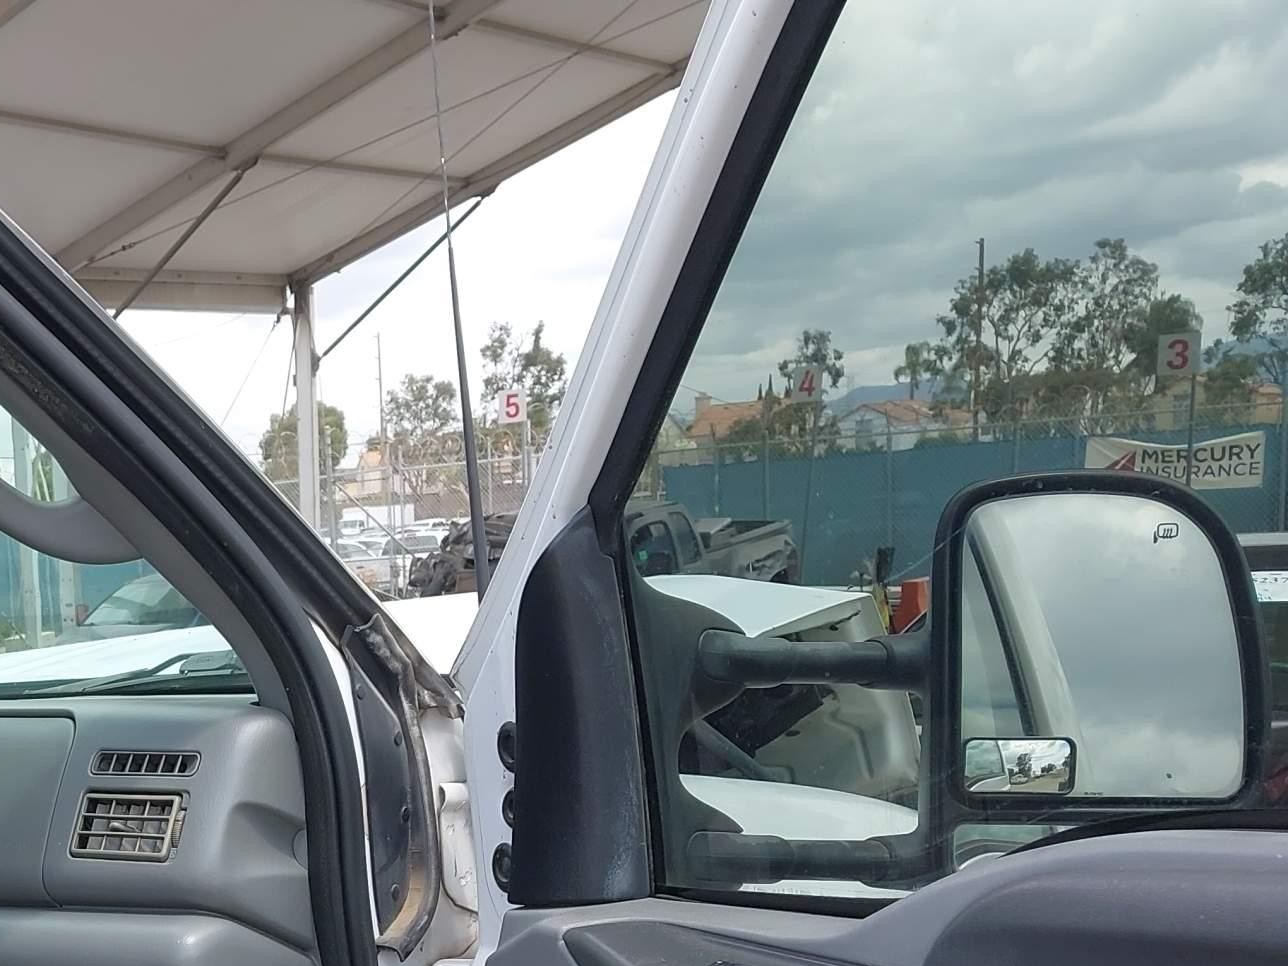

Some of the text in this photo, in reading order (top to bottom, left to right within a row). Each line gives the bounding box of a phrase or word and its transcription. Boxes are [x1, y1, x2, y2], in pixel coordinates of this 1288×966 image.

[1166, 338, 1190, 370] 3
[798, 369, 816, 398] 4
[505, 393, 520, 418] 5
[1141, 443, 1261, 464] MERCURY
